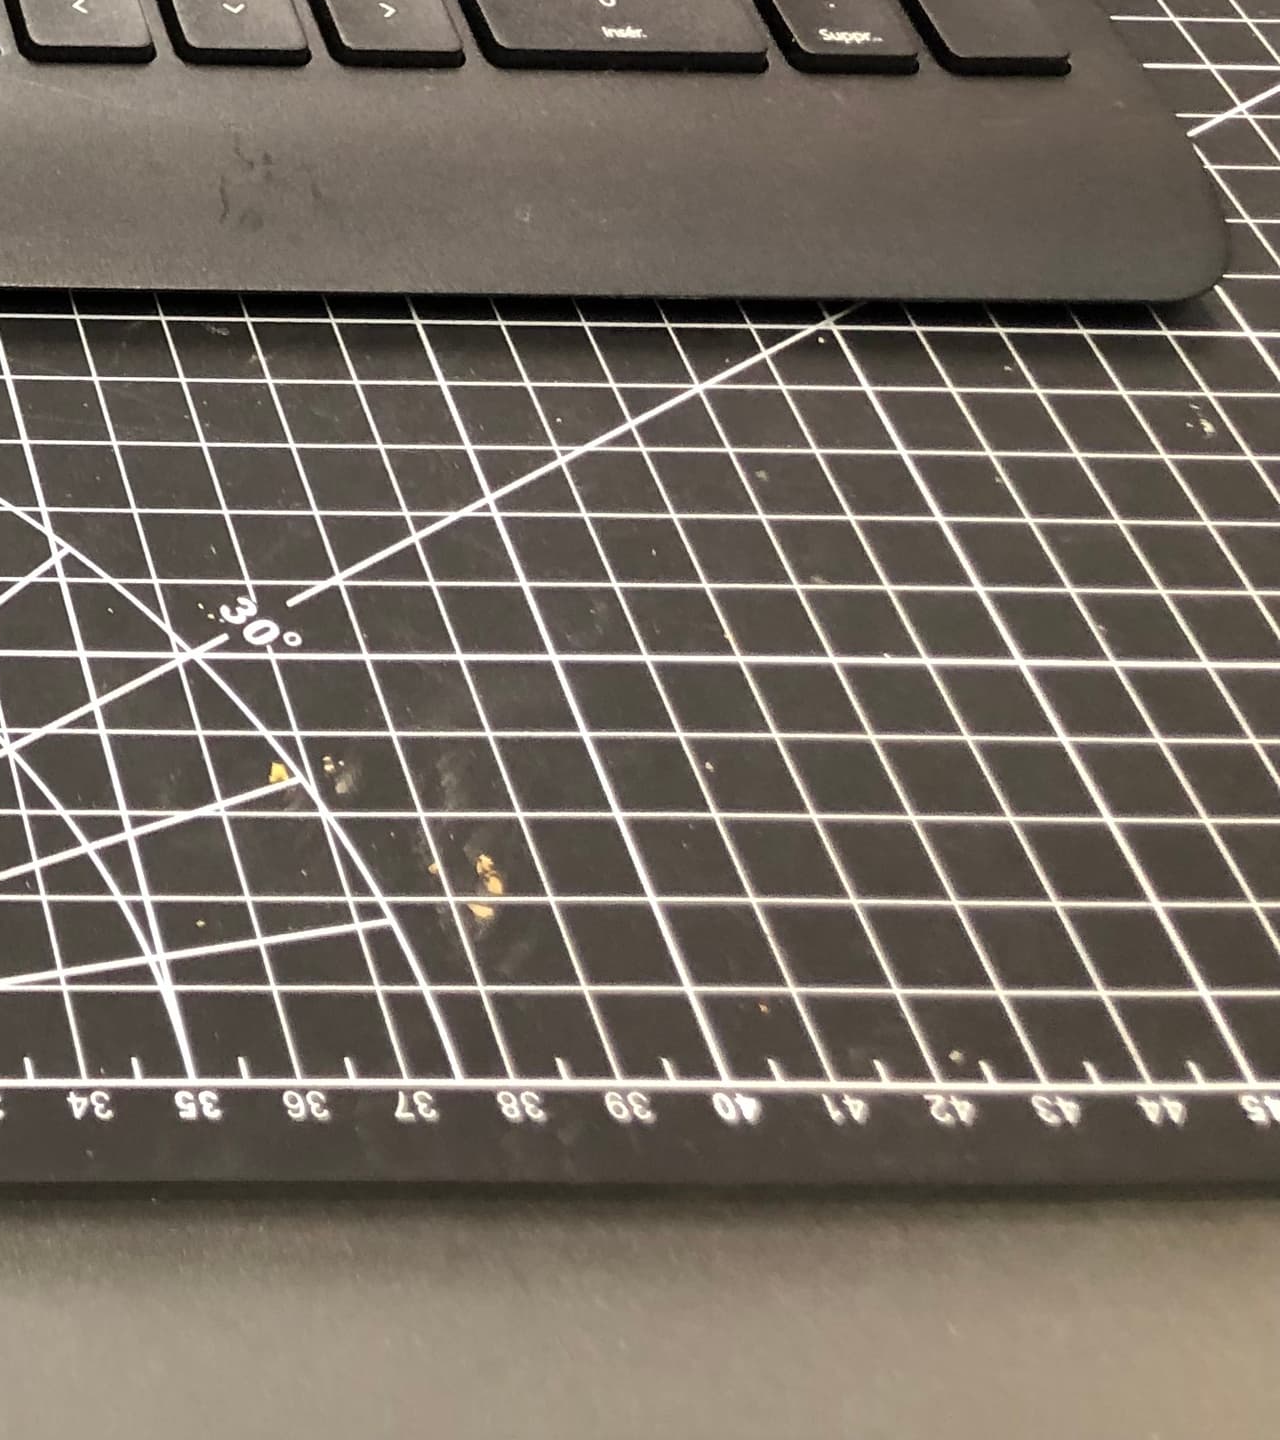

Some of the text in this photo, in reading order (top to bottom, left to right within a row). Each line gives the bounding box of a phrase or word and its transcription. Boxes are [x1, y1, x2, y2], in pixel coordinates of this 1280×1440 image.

[601, 26, 647, 38] Insér.
[218, 596, 302, 648] 30°
[66, 1090, 114, 1120] 34
[174, 1090, 222, 1120] 35
[283, 1090, 330, 1121] 36
[394, 1093, 439, 1121] 37
[496, 1093, 546, 1122] 38
[604, 1093, 654, 1122] 39
[712, 1093, 761, 1122] 40
[821, 1093, 868, 1123] 41
[923, 1093, 975, 1124] 42
[1031, 1093, 1080, 1124] 43
[1136, 1094, 1186, 1124] 44
